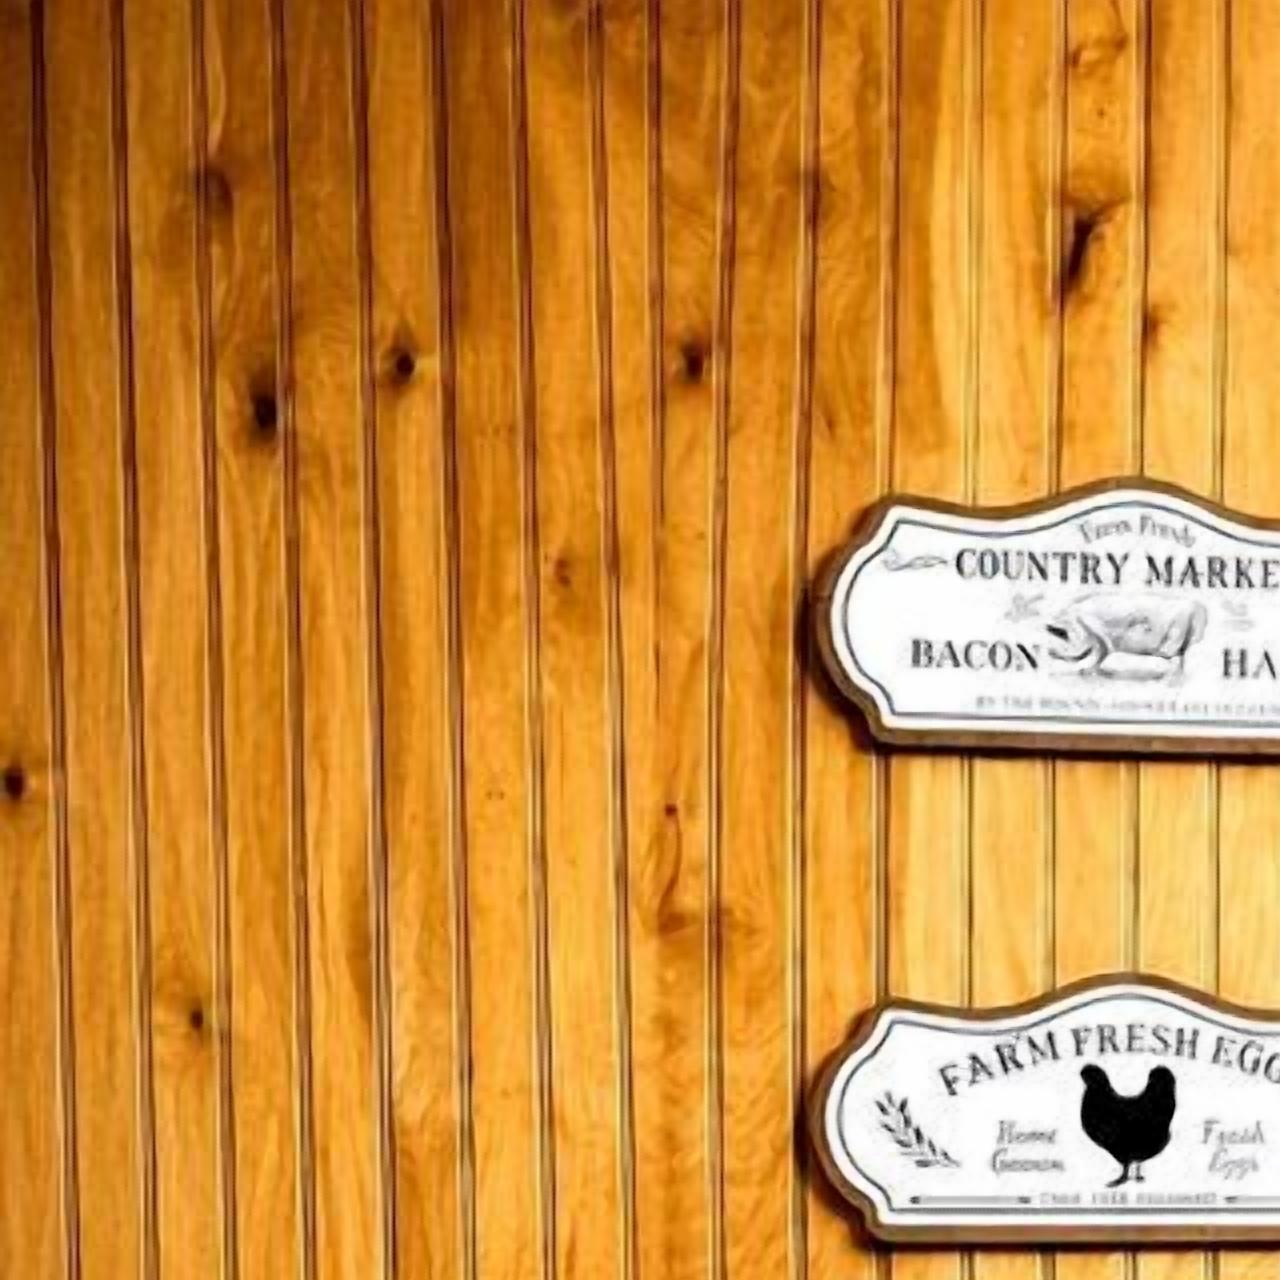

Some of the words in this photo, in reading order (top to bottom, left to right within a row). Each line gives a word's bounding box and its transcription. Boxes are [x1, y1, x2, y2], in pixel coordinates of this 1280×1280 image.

[954, 548, 1131, 585] COUNTRY
[910, 638, 1040, 672] BACON
[937, 1026, 1063, 1098] FARM
[1071, 1022, 1201, 1060] FRESH
